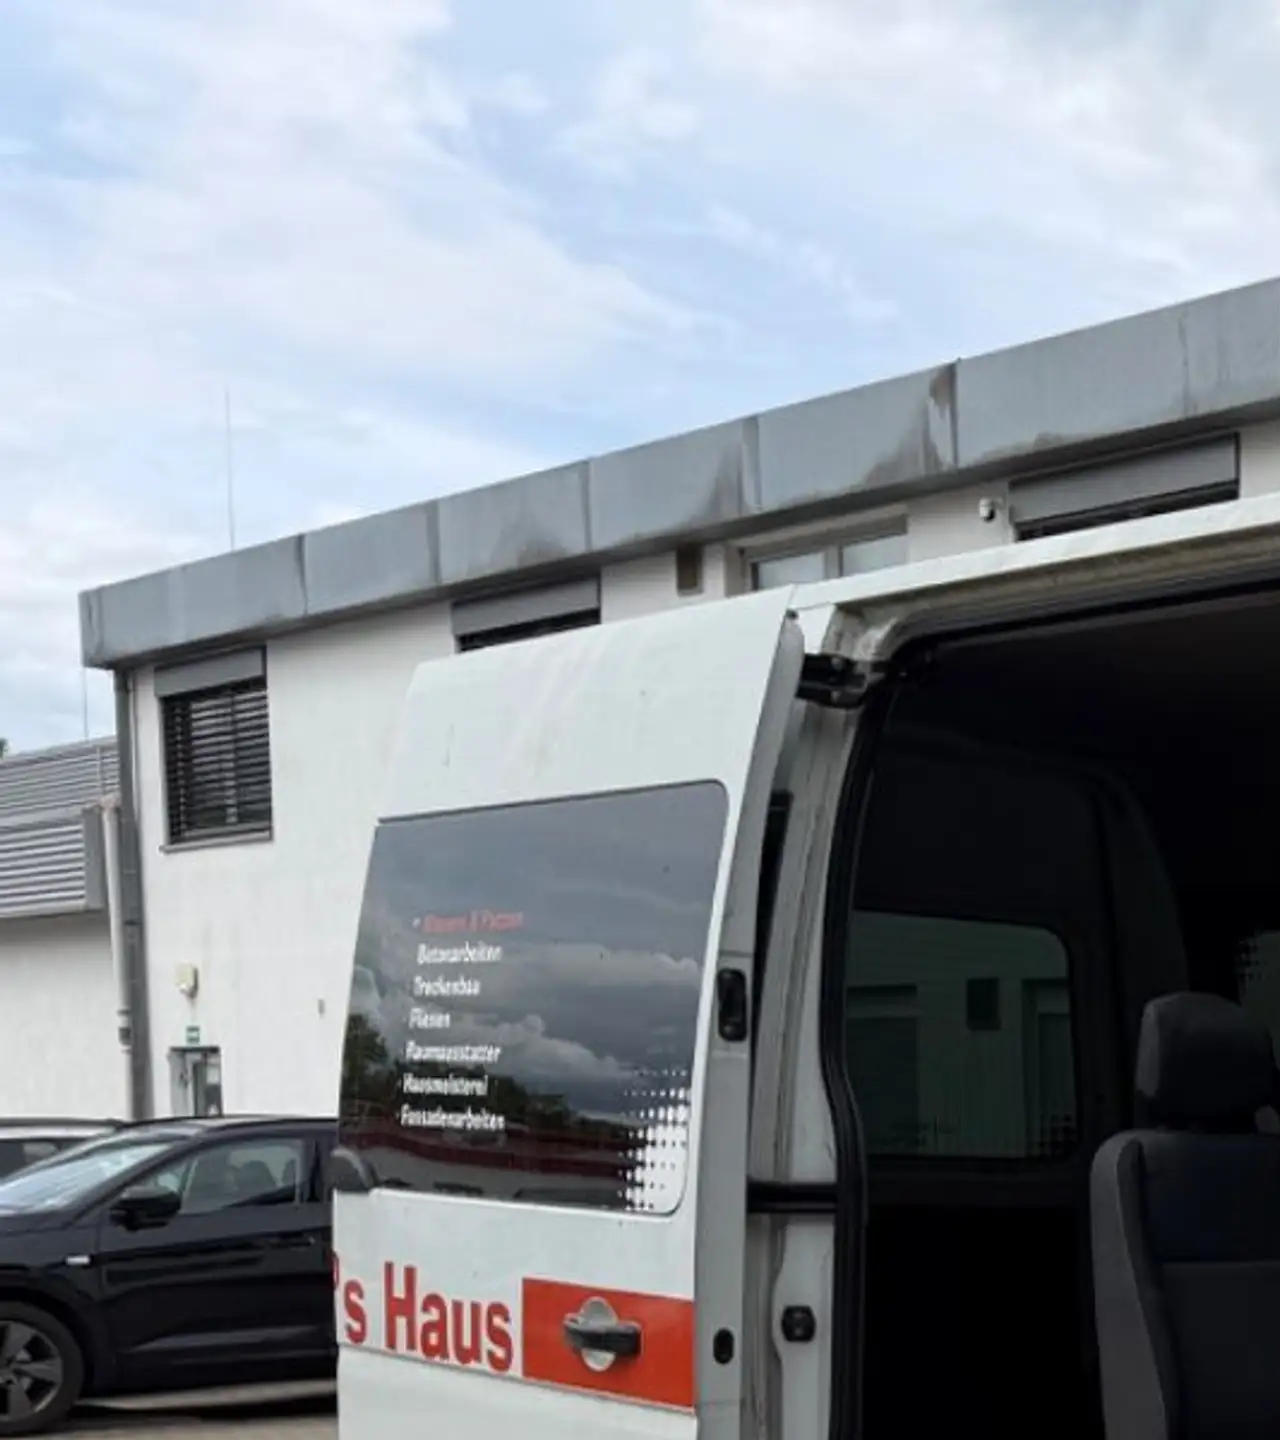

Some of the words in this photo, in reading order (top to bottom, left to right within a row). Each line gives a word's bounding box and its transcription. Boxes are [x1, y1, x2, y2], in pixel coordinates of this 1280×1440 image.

[417, 941, 502, 965] Betonarbeiten
[413, 975, 481, 996] Trockenbau
[409, 1007, 450, 1028] Fliesen
[405, 1041, 501, 1063] Raumausstatter
[384, 1261, 514, 1372] Haus
